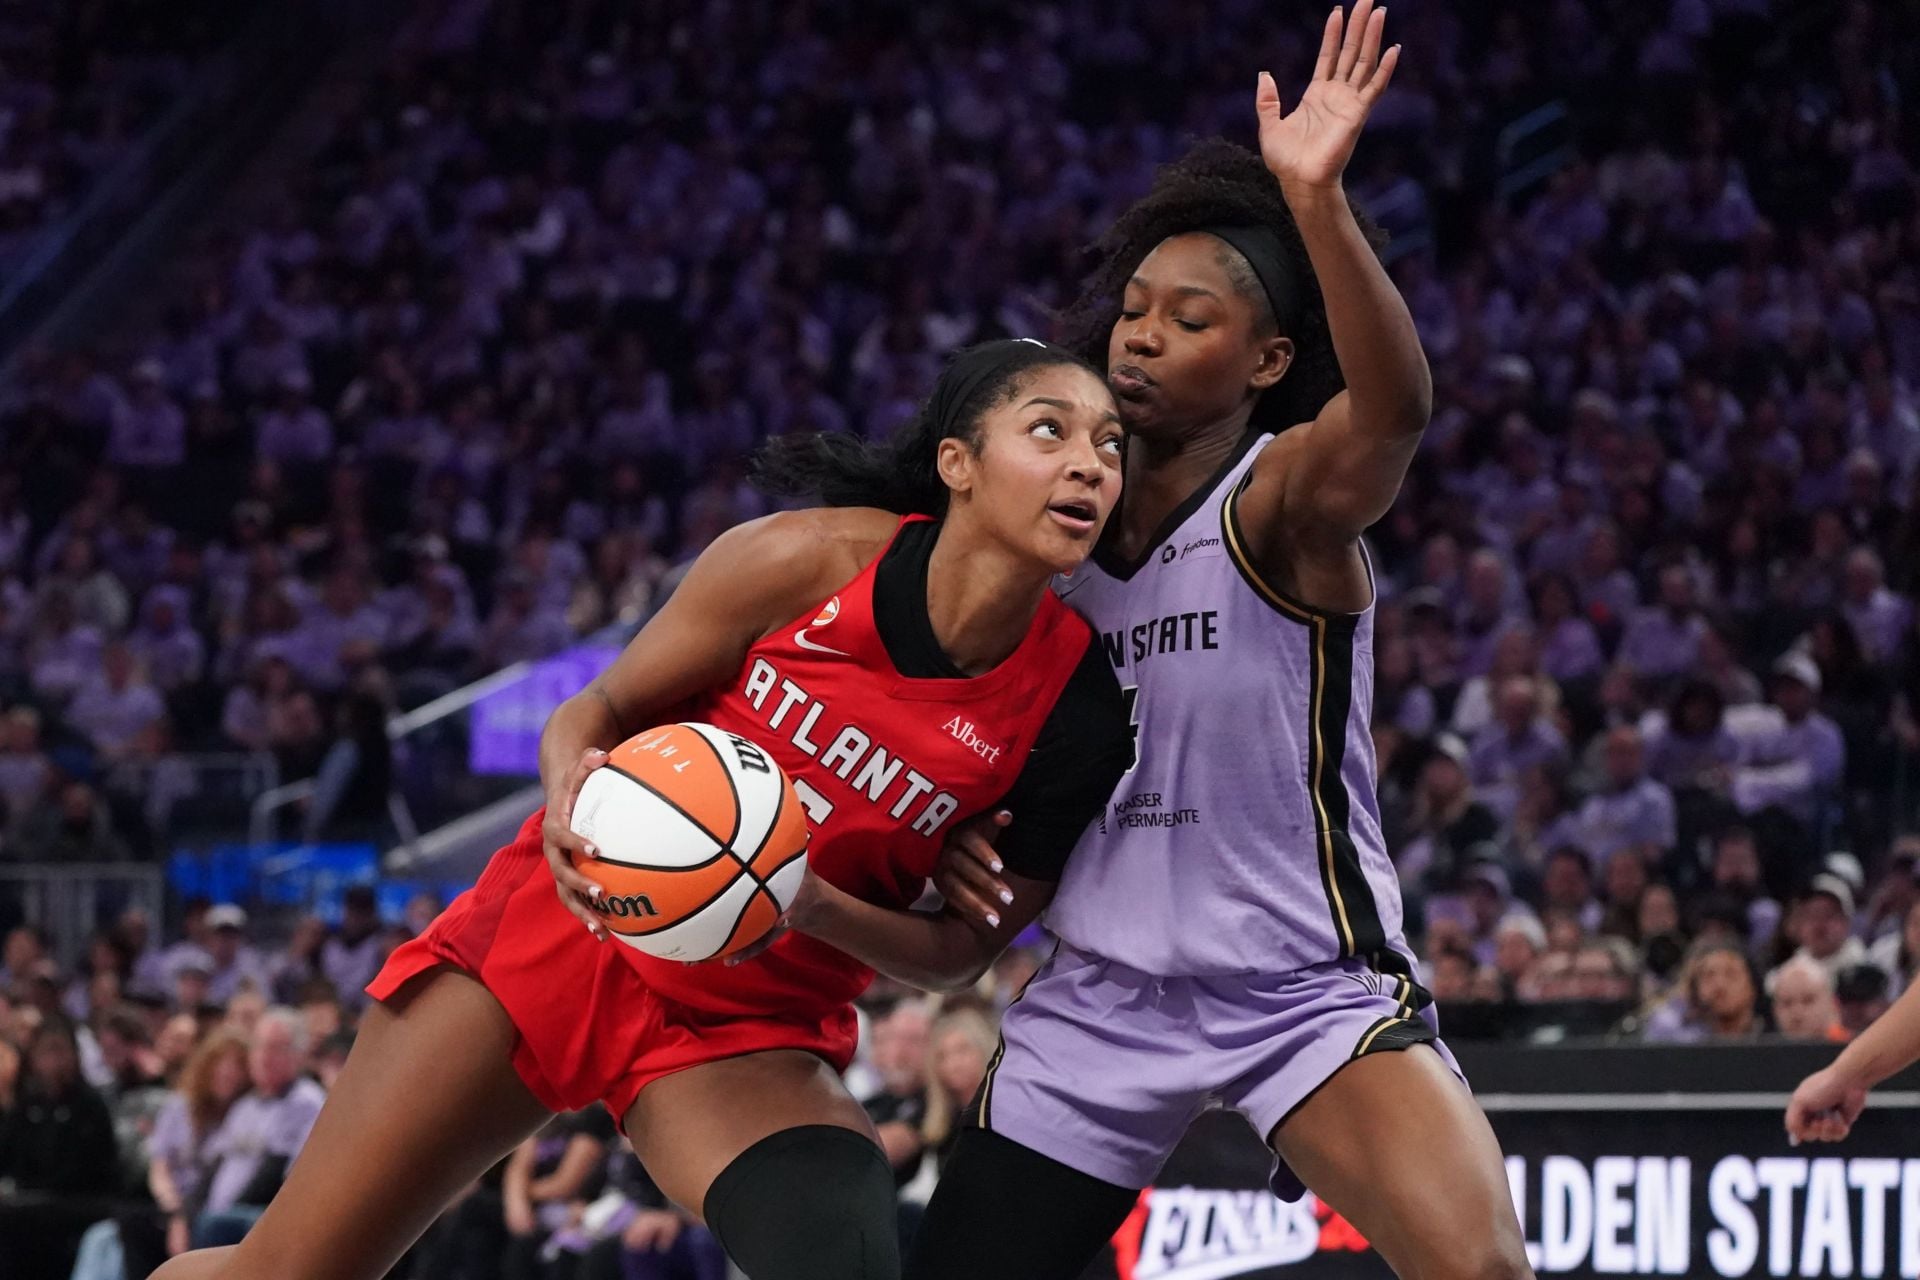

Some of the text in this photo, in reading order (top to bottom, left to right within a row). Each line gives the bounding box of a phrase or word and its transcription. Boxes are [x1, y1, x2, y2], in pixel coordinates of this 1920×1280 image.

[1180, 537, 1220, 561] frdom
[1131, 610, 1219, 664] STATE
[744, 656, 960, 838] ATLANTA
[941, 715, 1000, 764] Albert
[1113, 792, 1163, 816] KAISER
[1117, 808, 1201, 830] PERMAENTE
[1503, 1154, 1692, 1275] LDEN
